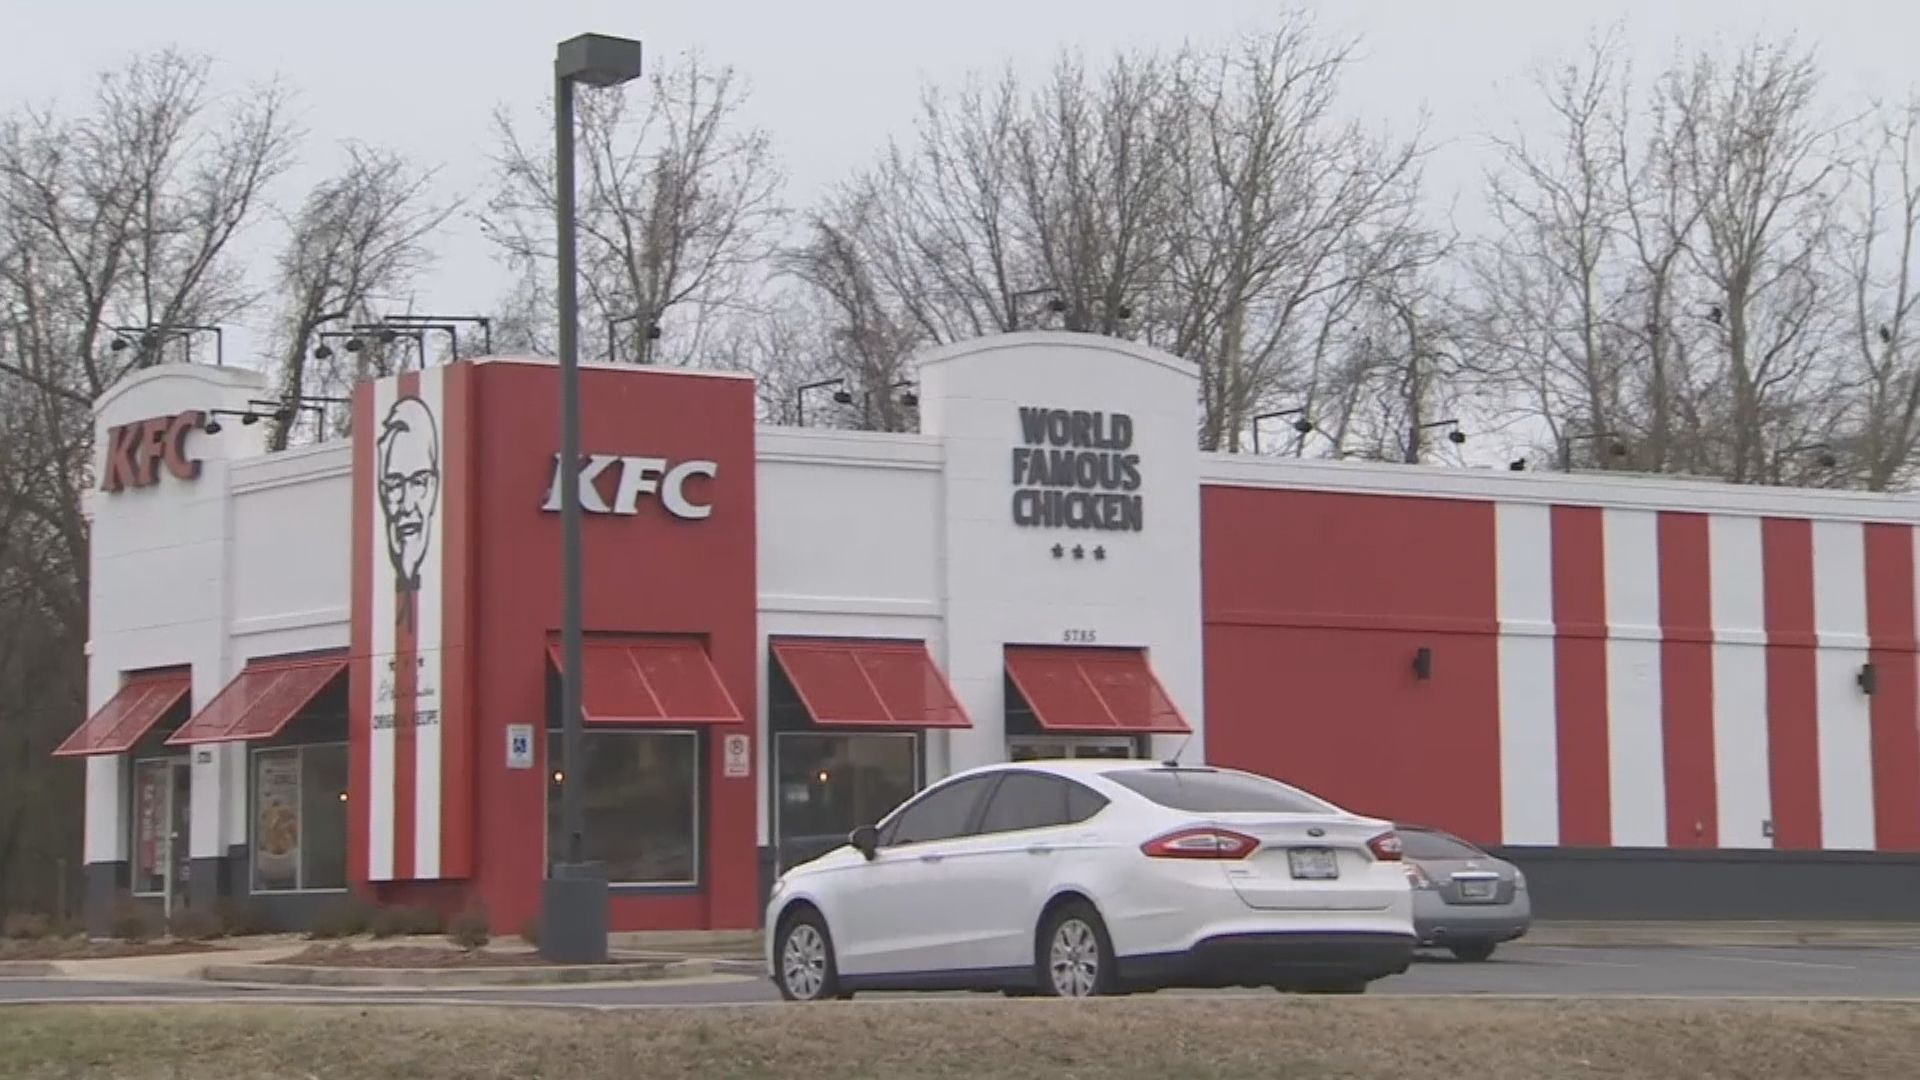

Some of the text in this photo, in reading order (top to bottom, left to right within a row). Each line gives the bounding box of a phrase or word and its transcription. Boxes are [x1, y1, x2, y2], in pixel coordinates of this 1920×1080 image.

[1018, 406, 1133, 450] WORLD
[100, 410, 206, 492] KFC
[1012, 448, 1142, 491] FAMOUS
[541, 452, 718, 519] KFC
[1012, 489, 1143, 532] CHICKEN
